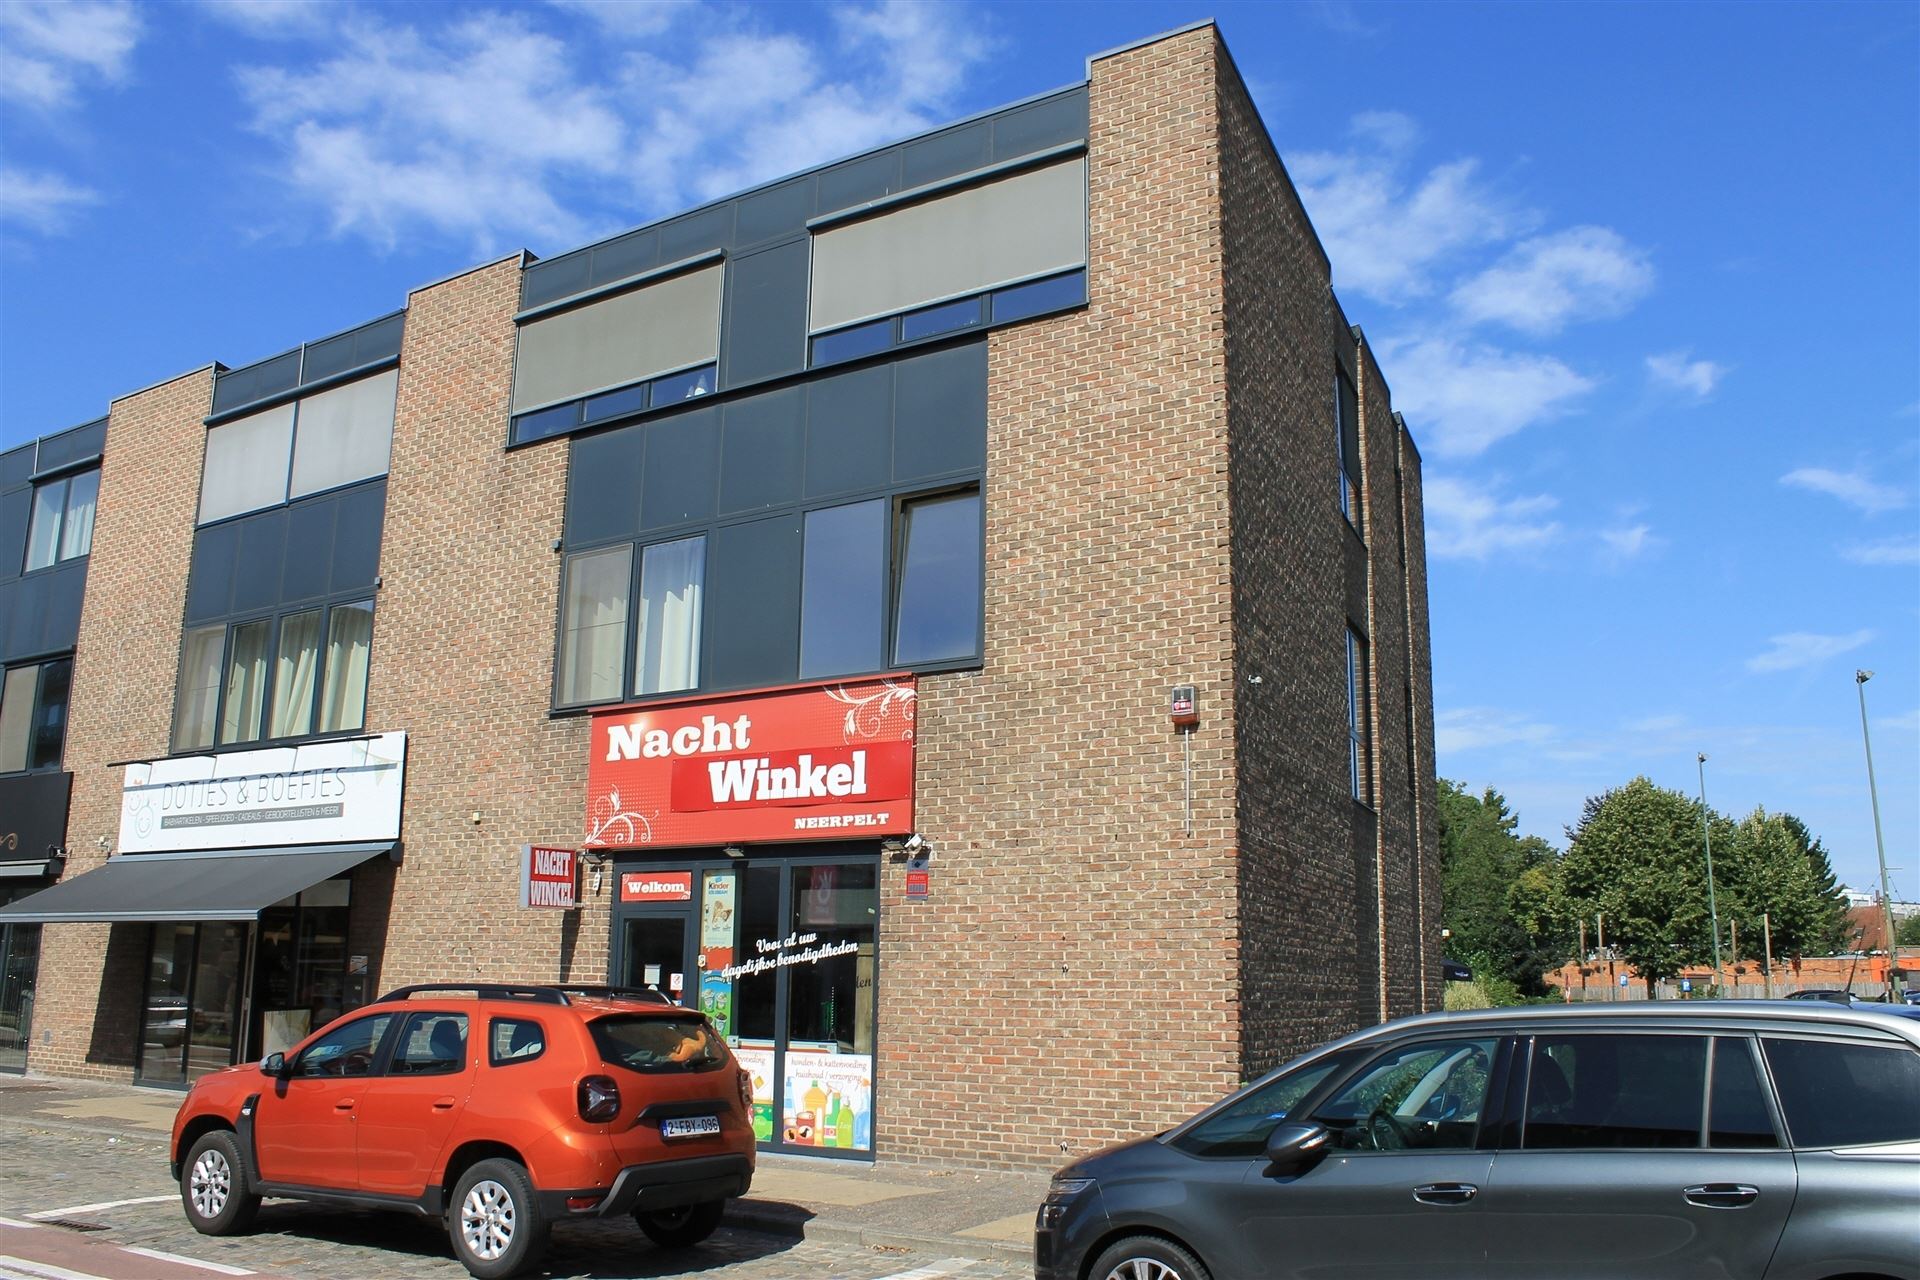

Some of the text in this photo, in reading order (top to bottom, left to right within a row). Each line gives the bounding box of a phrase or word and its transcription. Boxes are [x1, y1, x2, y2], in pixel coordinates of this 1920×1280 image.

[606, 714, 751, 762] Nacht
[708, 750, 866, 803] Winkel
[162, 767, 346, 811] DOTJES & BOEFJES
[206, 813, 235, 824] SPEELGOED
[238, 810, 261, 822] CADEAUS
[794, 812, 889, 829] NEERPELT
[534, 850, 571, 877] NACHT
[530, 881, 573, 907] WINKEL
[628, 881, 685, 894] Welkom
[755, 932, 817, 953] Voor al uw
[721, 940, 859, 980] dagelijkse benodigdheden
[824, 1058, 868, 1072] kattenvoeding
[829, 1072, 863, 1085] verzorging
[668, 1118, 718, 1134] 2-FBY-096
